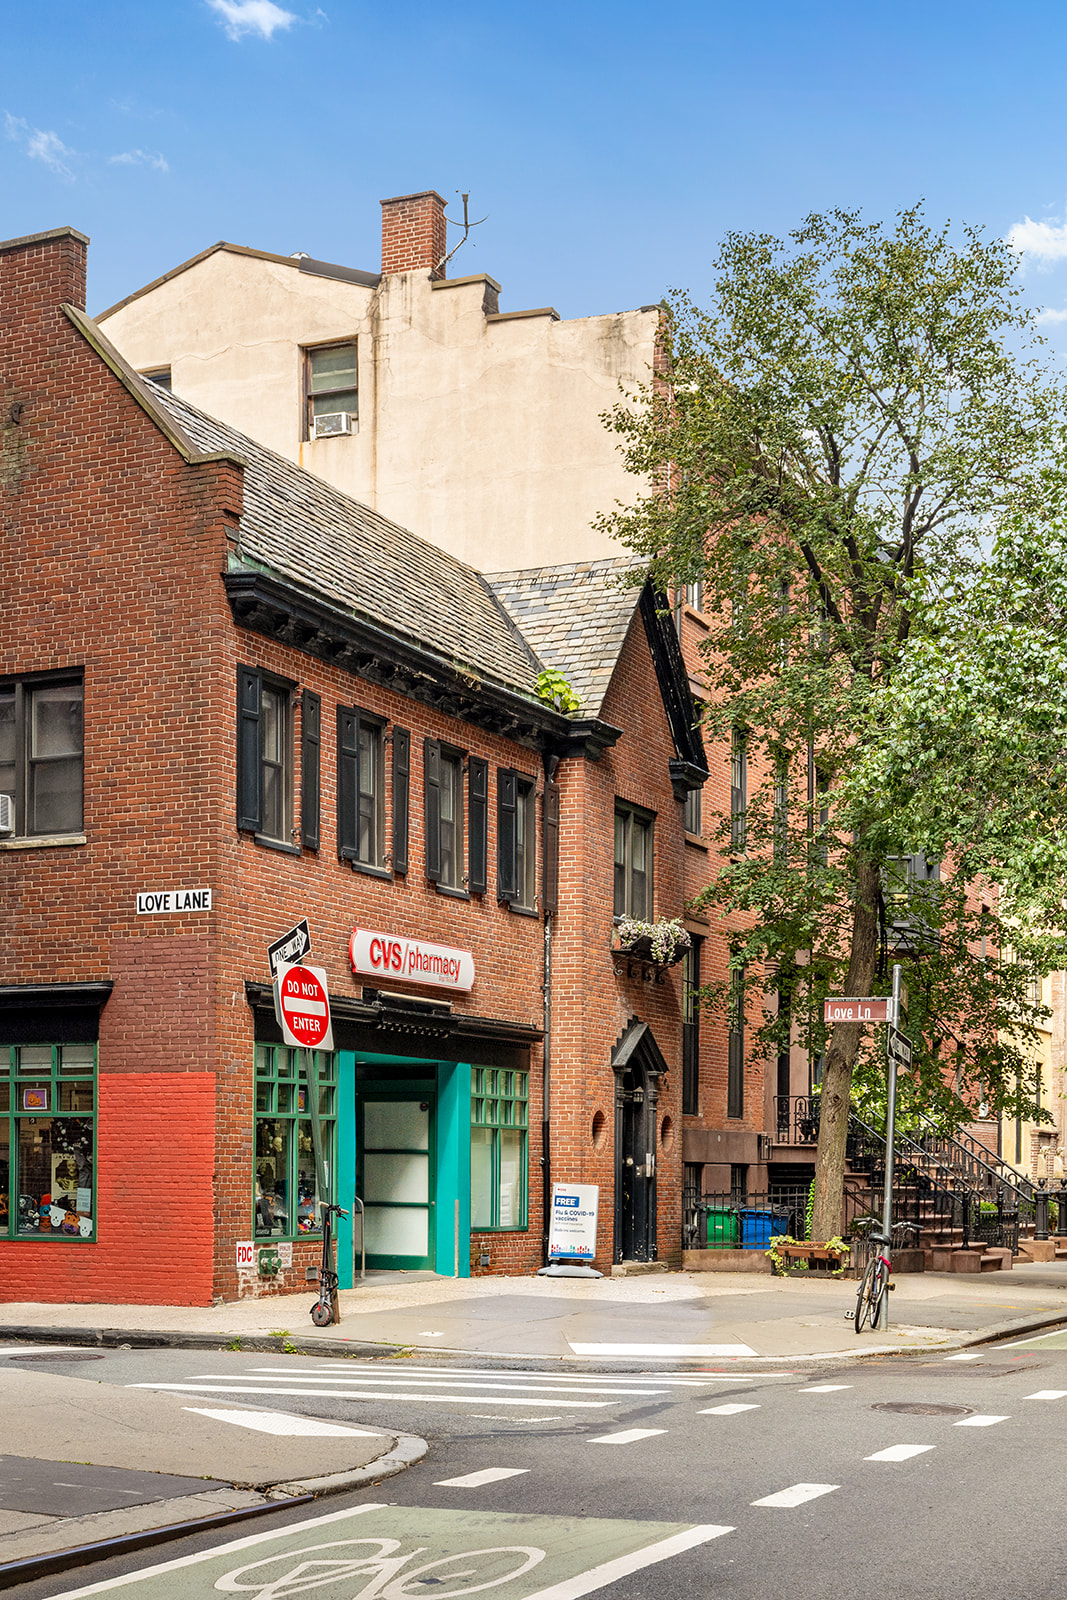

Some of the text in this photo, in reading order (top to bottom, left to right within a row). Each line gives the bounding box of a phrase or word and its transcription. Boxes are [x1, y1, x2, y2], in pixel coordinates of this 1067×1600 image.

[138, 891, 209, 912] LOVE LANE
[275, 933, 304, 962] ONE WAY
[287, 980, 318, 997] DO NOT
[828, 1004, 871, 1019] Love Ln
[293, 1016, 321, 1032] ENTER
[237, 1246, 253, 1263] FDC
